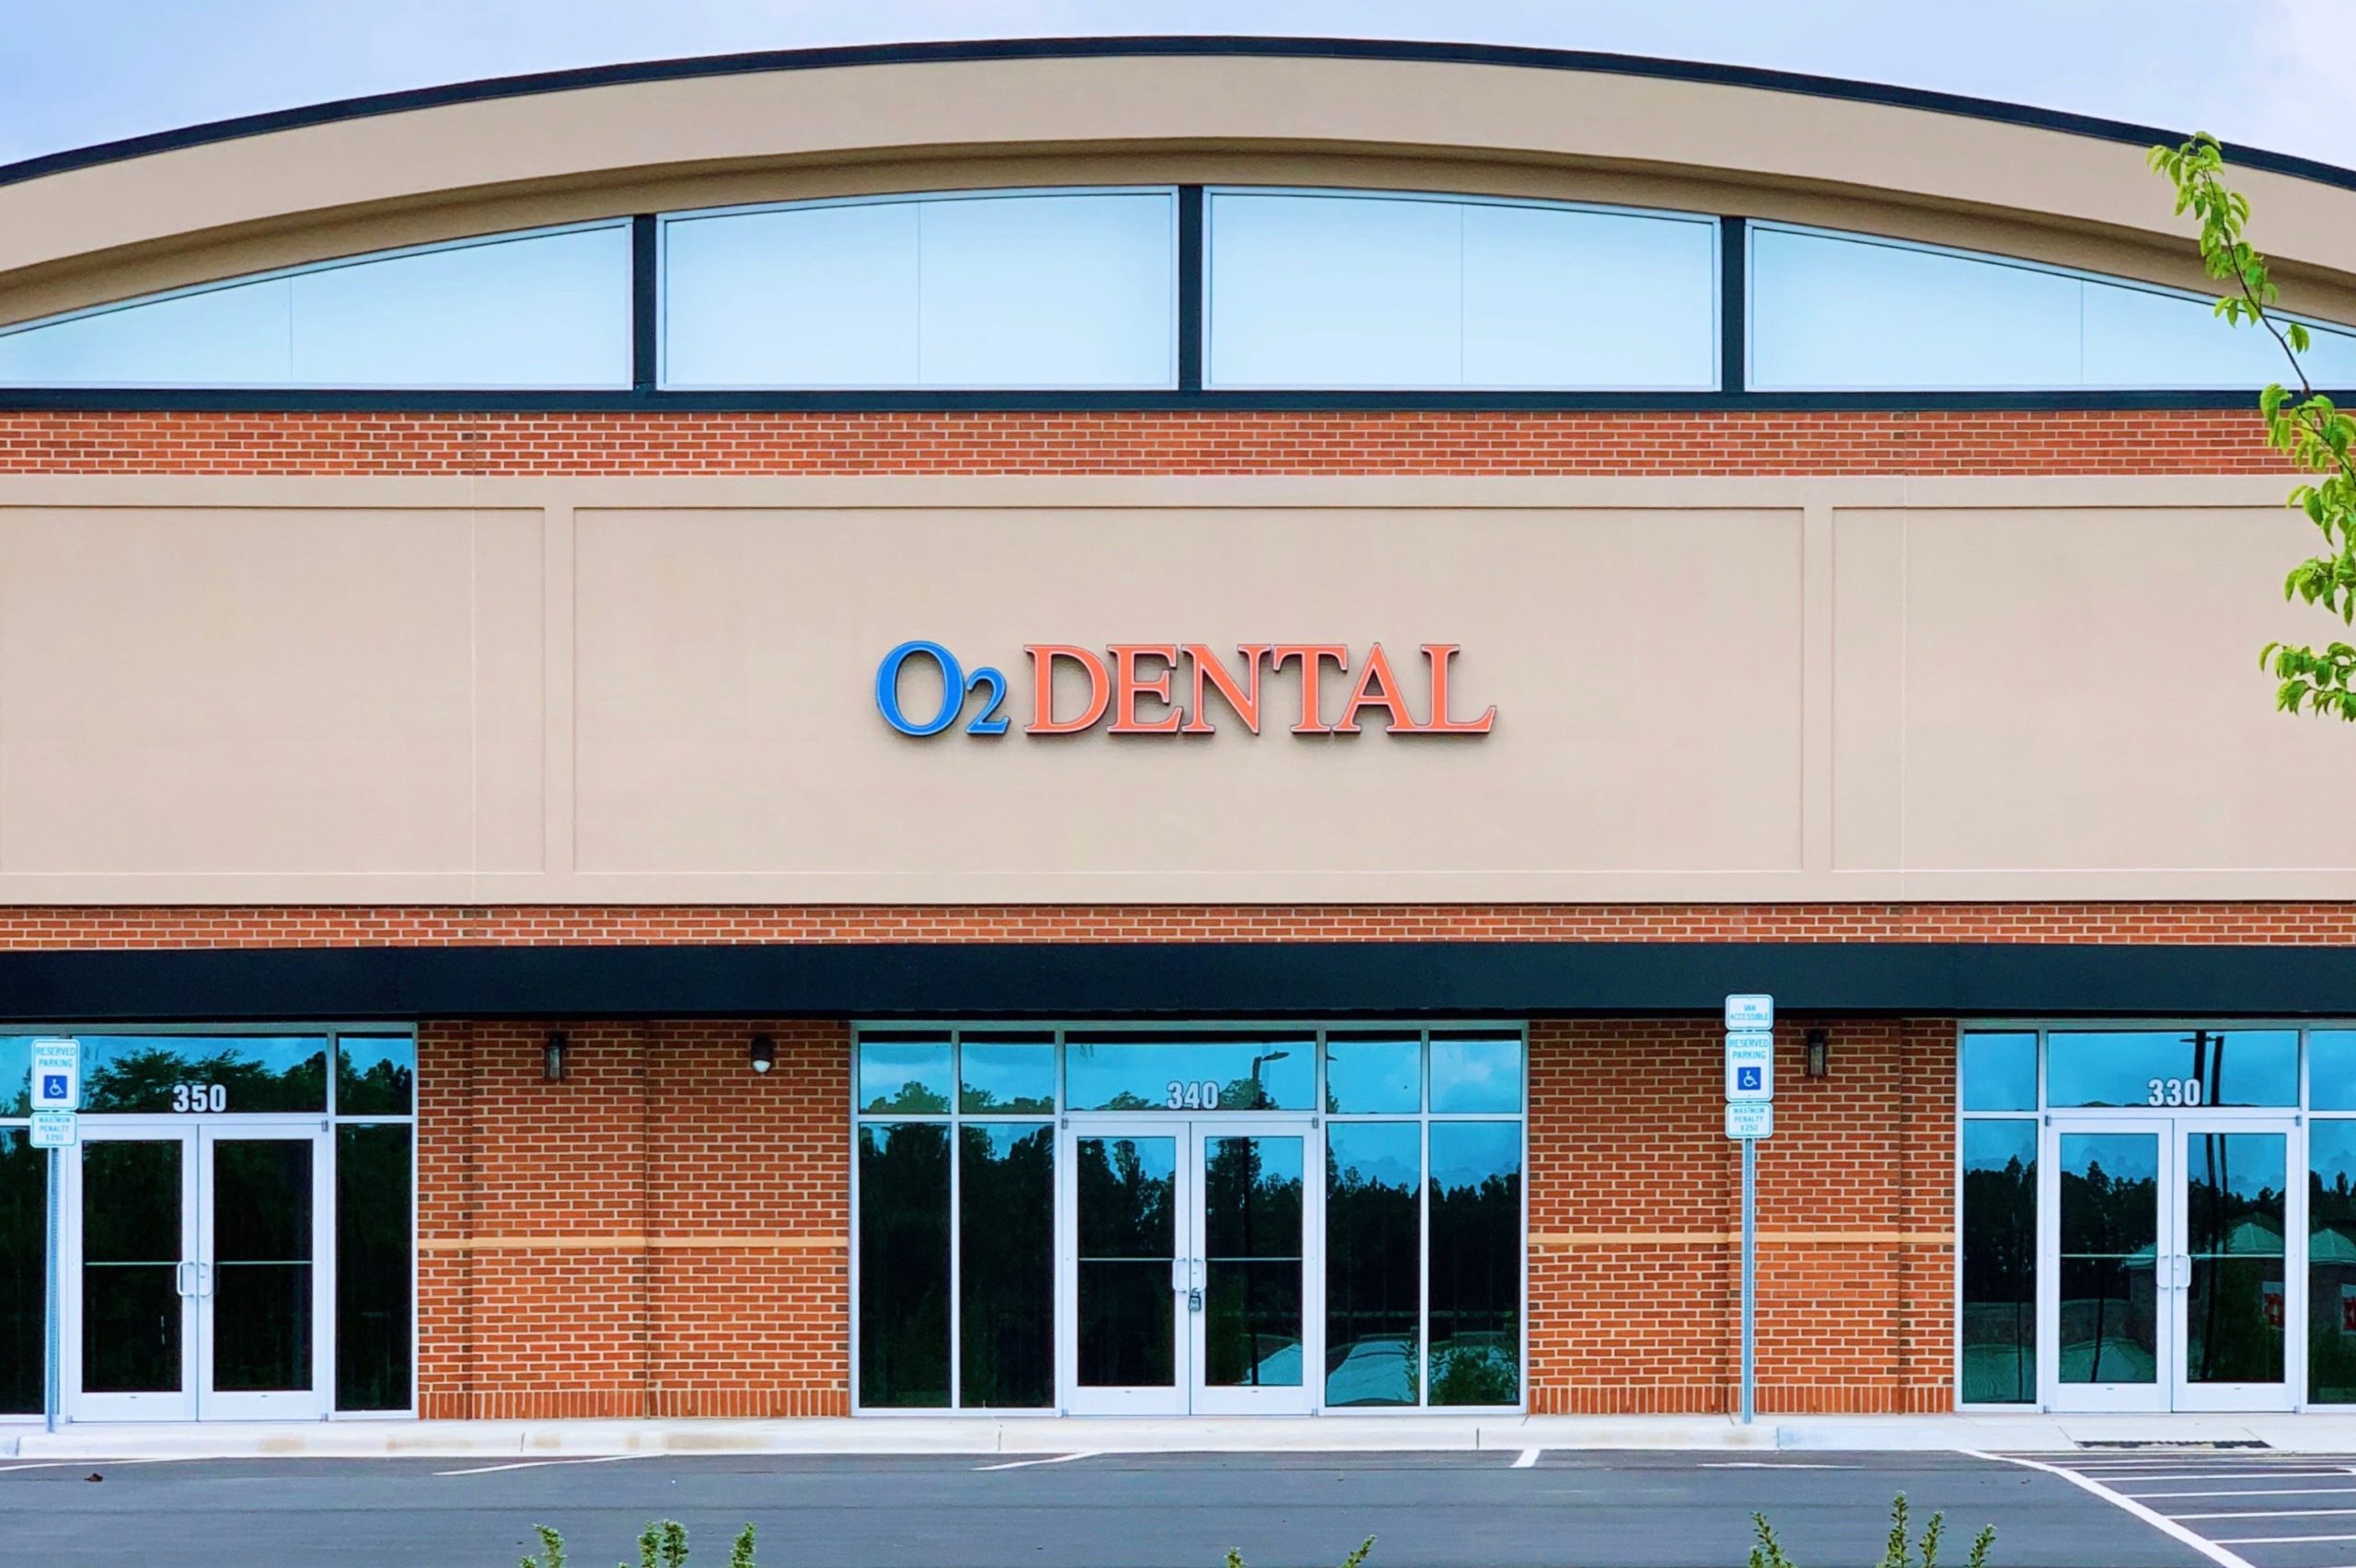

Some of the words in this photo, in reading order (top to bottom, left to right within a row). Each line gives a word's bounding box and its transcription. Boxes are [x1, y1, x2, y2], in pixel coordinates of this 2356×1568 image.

[876, 640, 1011, 735] O2
[1024, 642, 1498, 735] DENTAL
[1729, 1038, 1769, 1048] RESERVED
[35, 1046, 75, 1056] RESERVED
[1732, 1050, 1766, 1060] PARKING
[39, 1058, 74, 1068] PARKING
[1166, 1080, 1220, 1111] 340
[2148, 1078, 2201, 1107] 330
[172, 1084, 227, 1113] 350
[1734, 1115, 1763, 1124] PENALTY
